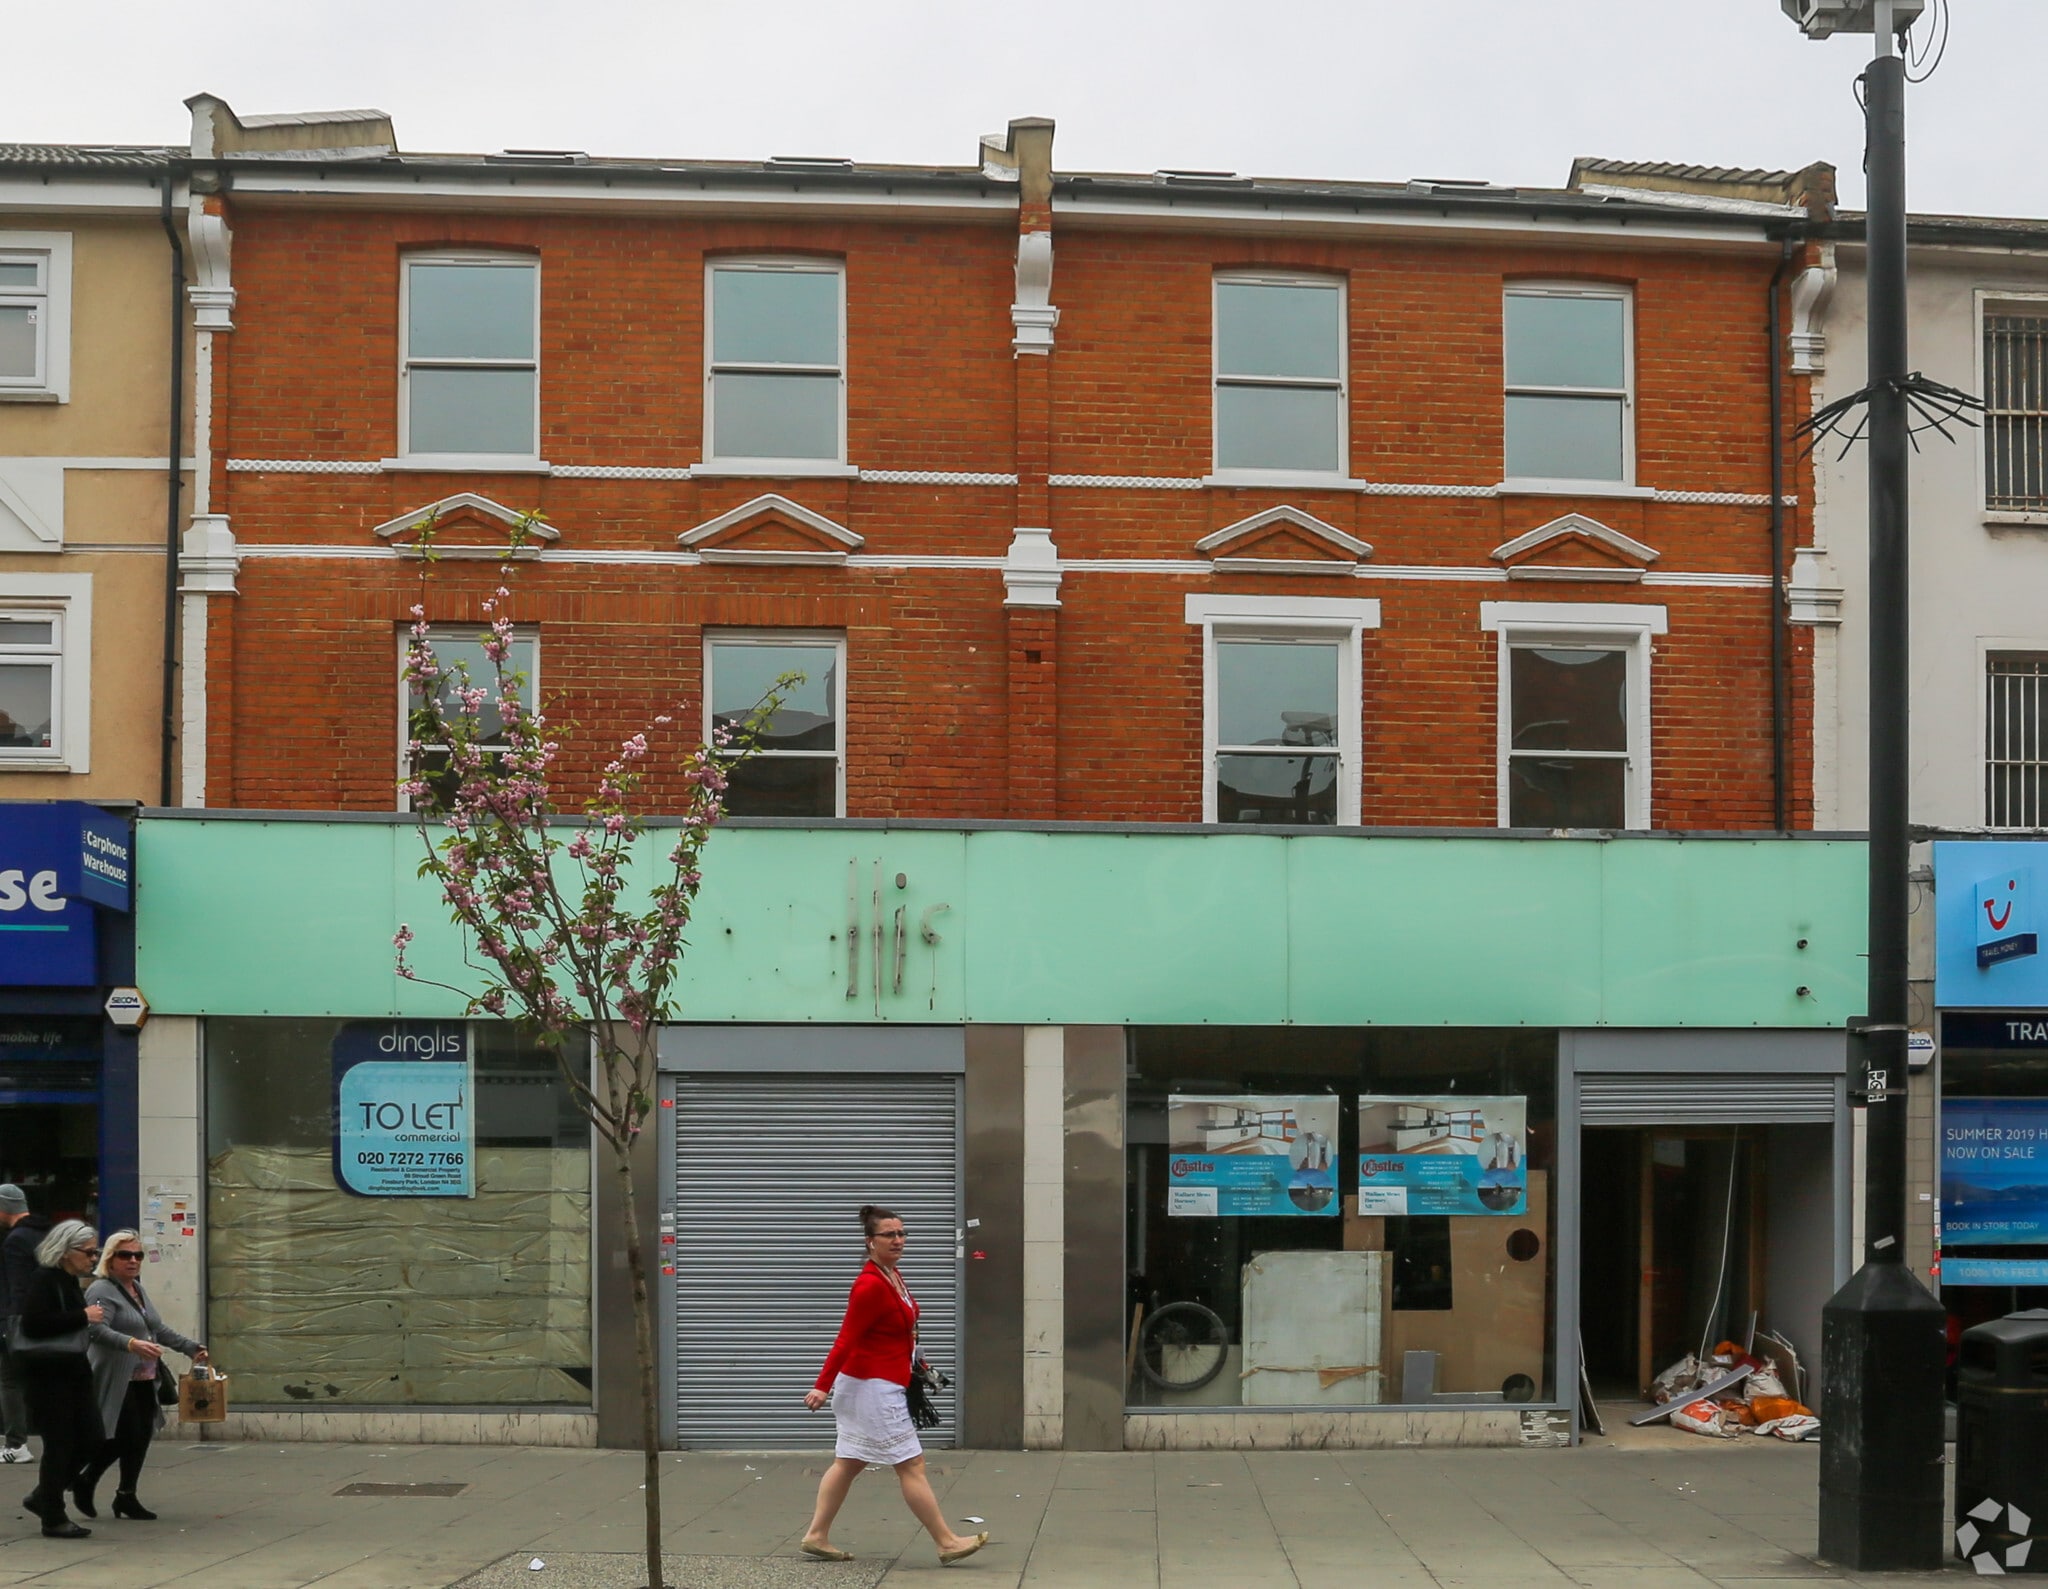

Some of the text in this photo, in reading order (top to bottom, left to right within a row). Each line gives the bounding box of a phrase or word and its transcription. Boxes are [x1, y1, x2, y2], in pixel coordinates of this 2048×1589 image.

[87, 830, 127, 860] Carphone
[83, 851, 127, 881] Warehouse
[0, 869, 67, 911] se
[111, 996, 138, 1004] SECOM
[2005, 1022, 2048, 1040] TRA
[42, 1031, 62, 1050] life
[379, 1023, 461, 1060] dinglis
[359, 1102, 462, 1130] TO LET
[394, 1132, 461, 1142] commercial
[1946, 1128, 2003, 1140] SUMMER
[2006, 1128, 2035, 1140] 2019
[357, 1152, 464, 1165] 020 7272 7766
[1947, 1146, 2035, 1159] NOW ON SALE
[1946, 1222, 2039, 1231] BOOK IN STORE TODAY
